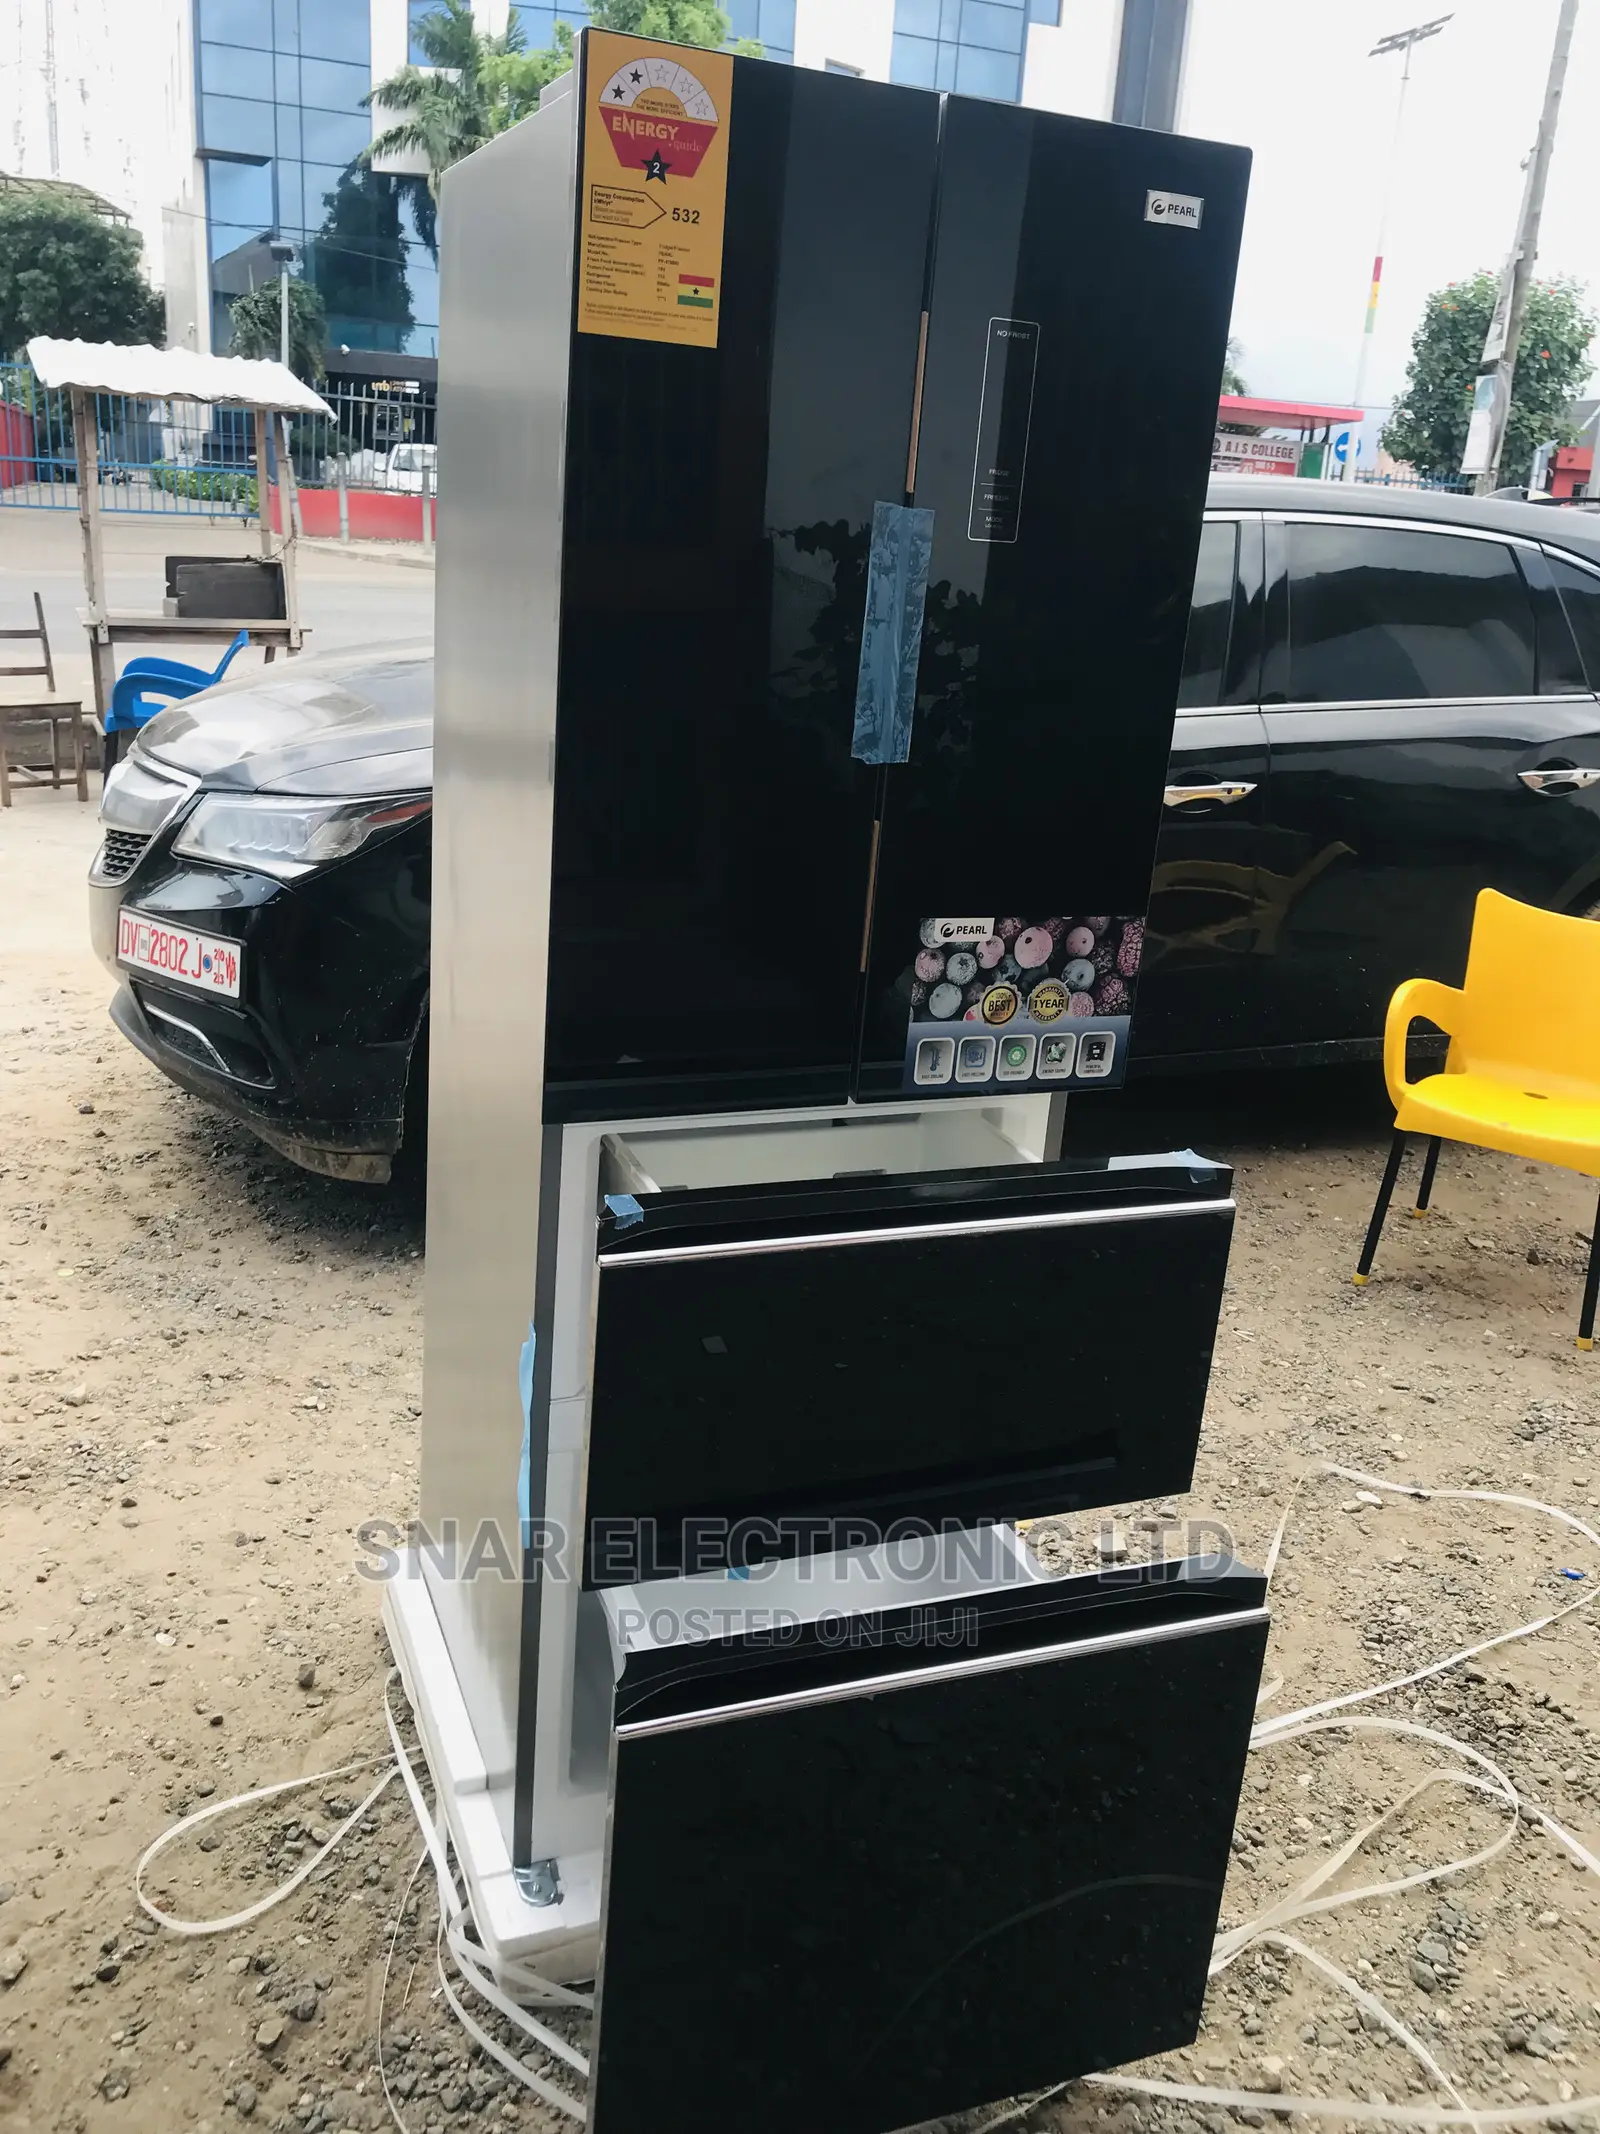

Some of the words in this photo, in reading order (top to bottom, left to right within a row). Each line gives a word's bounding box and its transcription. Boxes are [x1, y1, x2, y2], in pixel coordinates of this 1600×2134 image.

[612, 112, 680, 140] ENERGY
[652, 162, 660, 174] 2
[671, 207, 701, 225] 532
[1167, 203, 1197, 218] PEARL
[996, 329, 1008, 338] NO
[1251, 443, 1295, 459] COLLEGE
[956, 925, 988, 936] PEARL
[121, 918, 138, 957] DV
[149, 929, 188, 975] 2802
[987, 999, 1012, 1012] BEST
